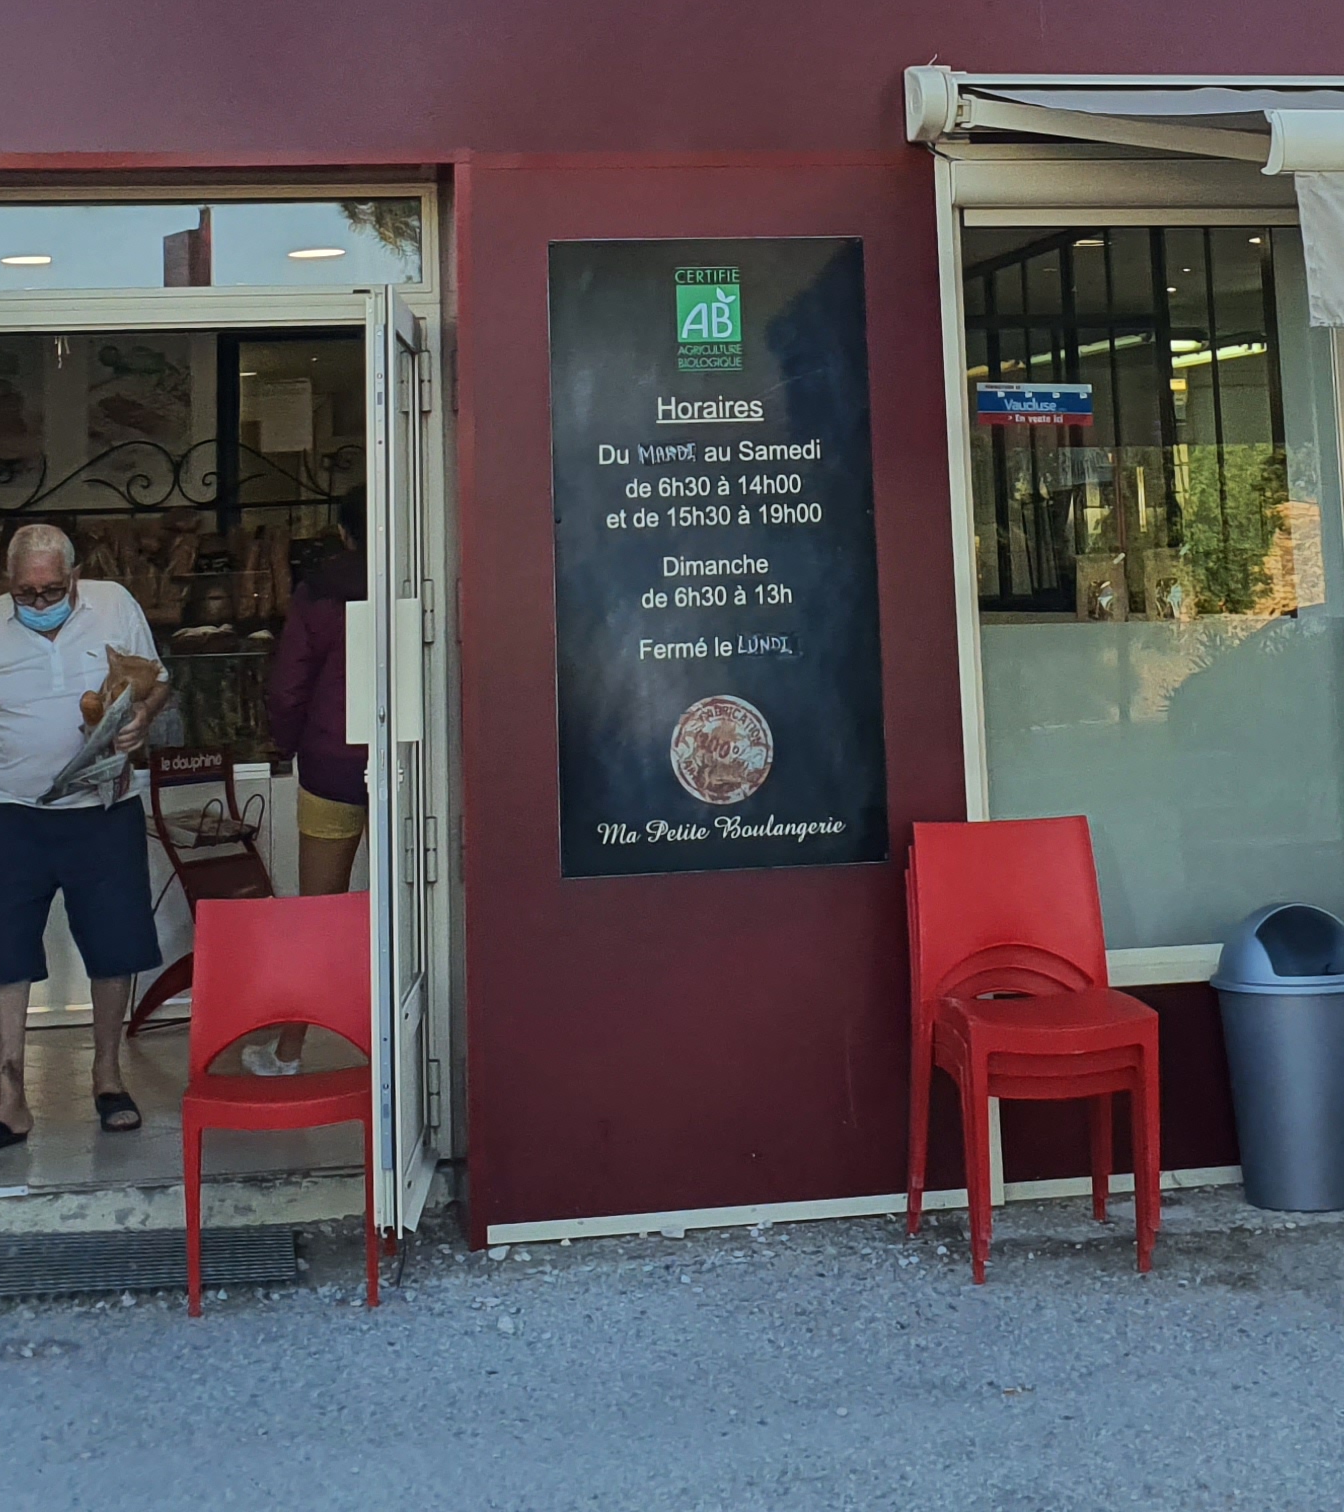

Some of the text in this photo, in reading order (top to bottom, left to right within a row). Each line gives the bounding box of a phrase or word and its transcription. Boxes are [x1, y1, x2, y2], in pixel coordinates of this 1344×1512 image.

[681, 301, 733, 339] AB
[677, 344, 743, 356] AGRICULTURE
[678, 356, 743, 368] BIOLOGIQUE
[657, 396, 764, 420] Horaires
[1003, 398, 1057, 412] Vaucluse
[599, 439, 822, 465] Du MARDI au Samedi
[625, 474, 802, 498] de 6h30 à 14h00
[606, 502, 823, 529] et de 15h30 à 19h00
[663, 554, 769, 577] Dimanche
[641, 583, 793, 609] de 6h30 à 13h
[639, 635, 793, 660] Fermé le LUNDI
[597, 814, 846, 845] Ma Petite Boulangerie
